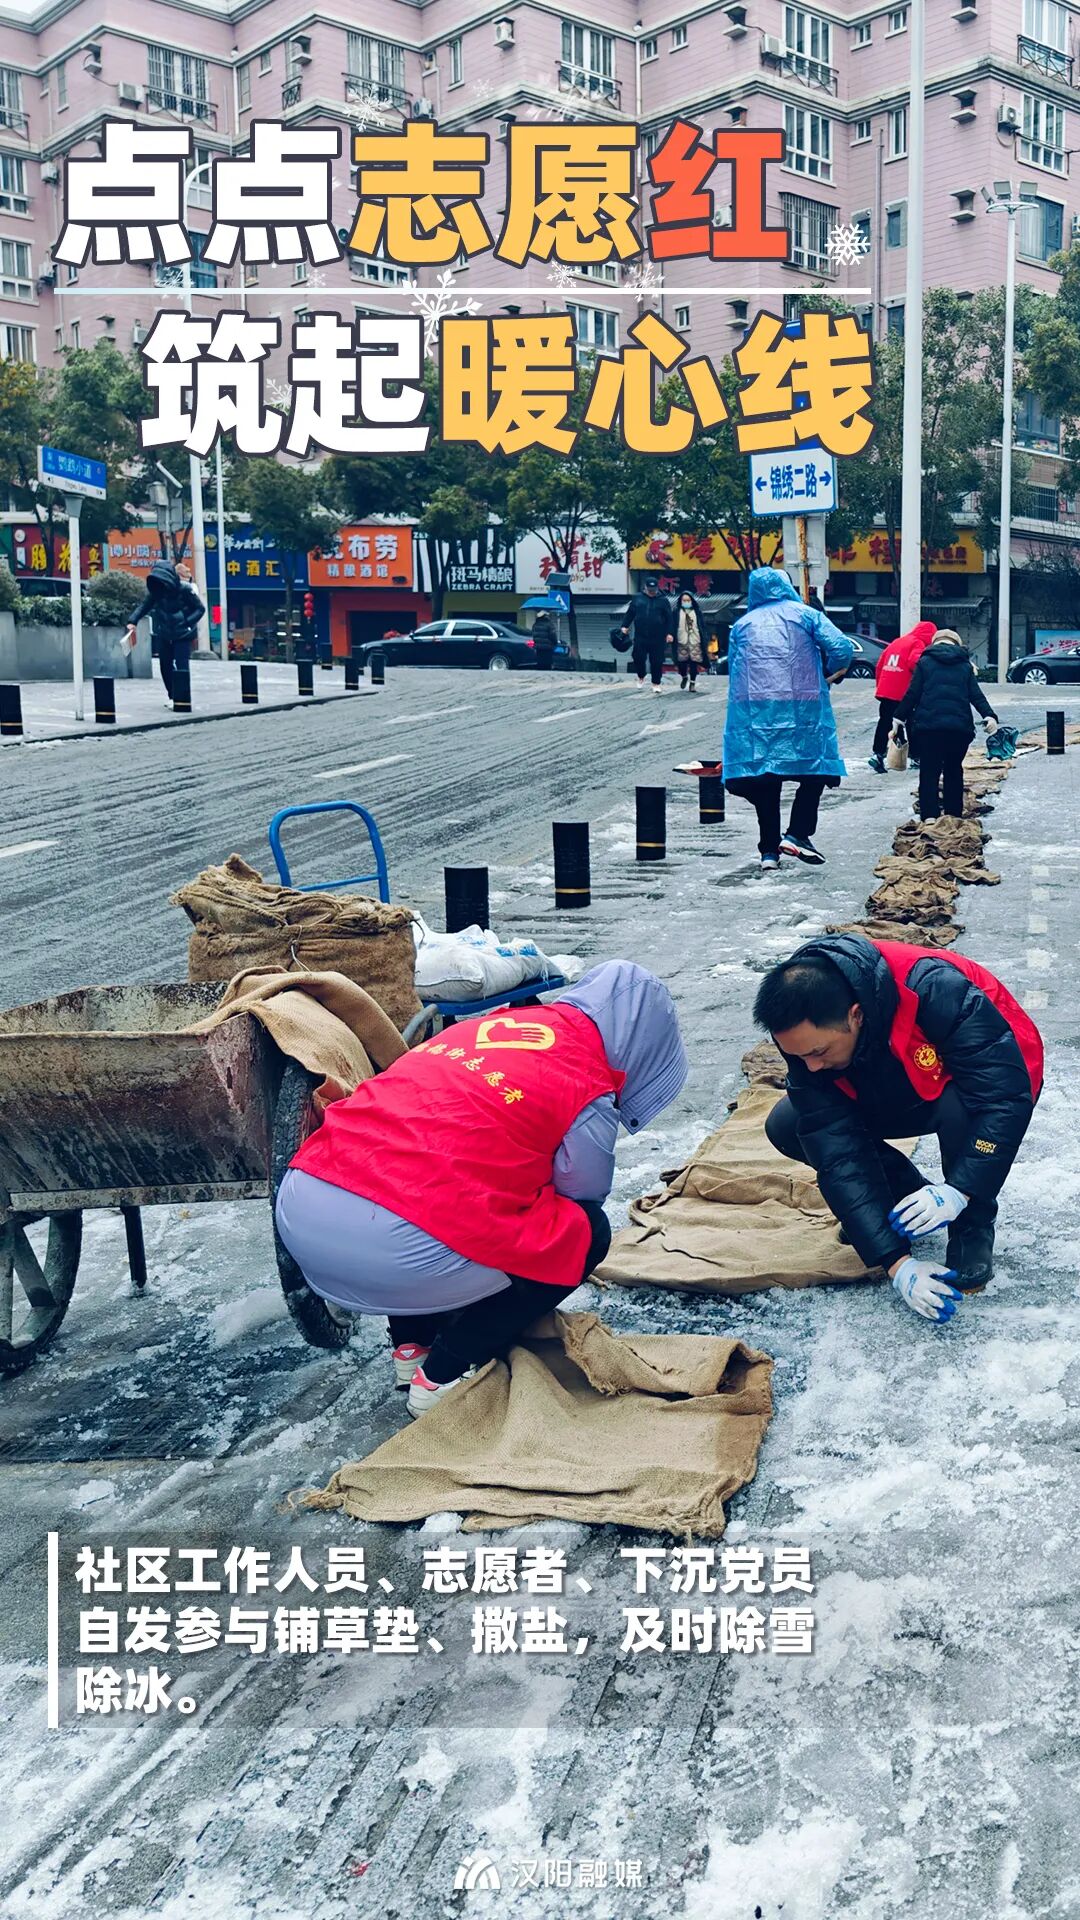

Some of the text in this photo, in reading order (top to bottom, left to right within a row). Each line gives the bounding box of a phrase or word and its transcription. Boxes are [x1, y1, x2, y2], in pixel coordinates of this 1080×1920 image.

[770, 463, 818, 500] 锦绣二路
[450, 566, 513, 583] 斑马精酿
[451, 583, 513, 591] ZEBRA CRAFT
